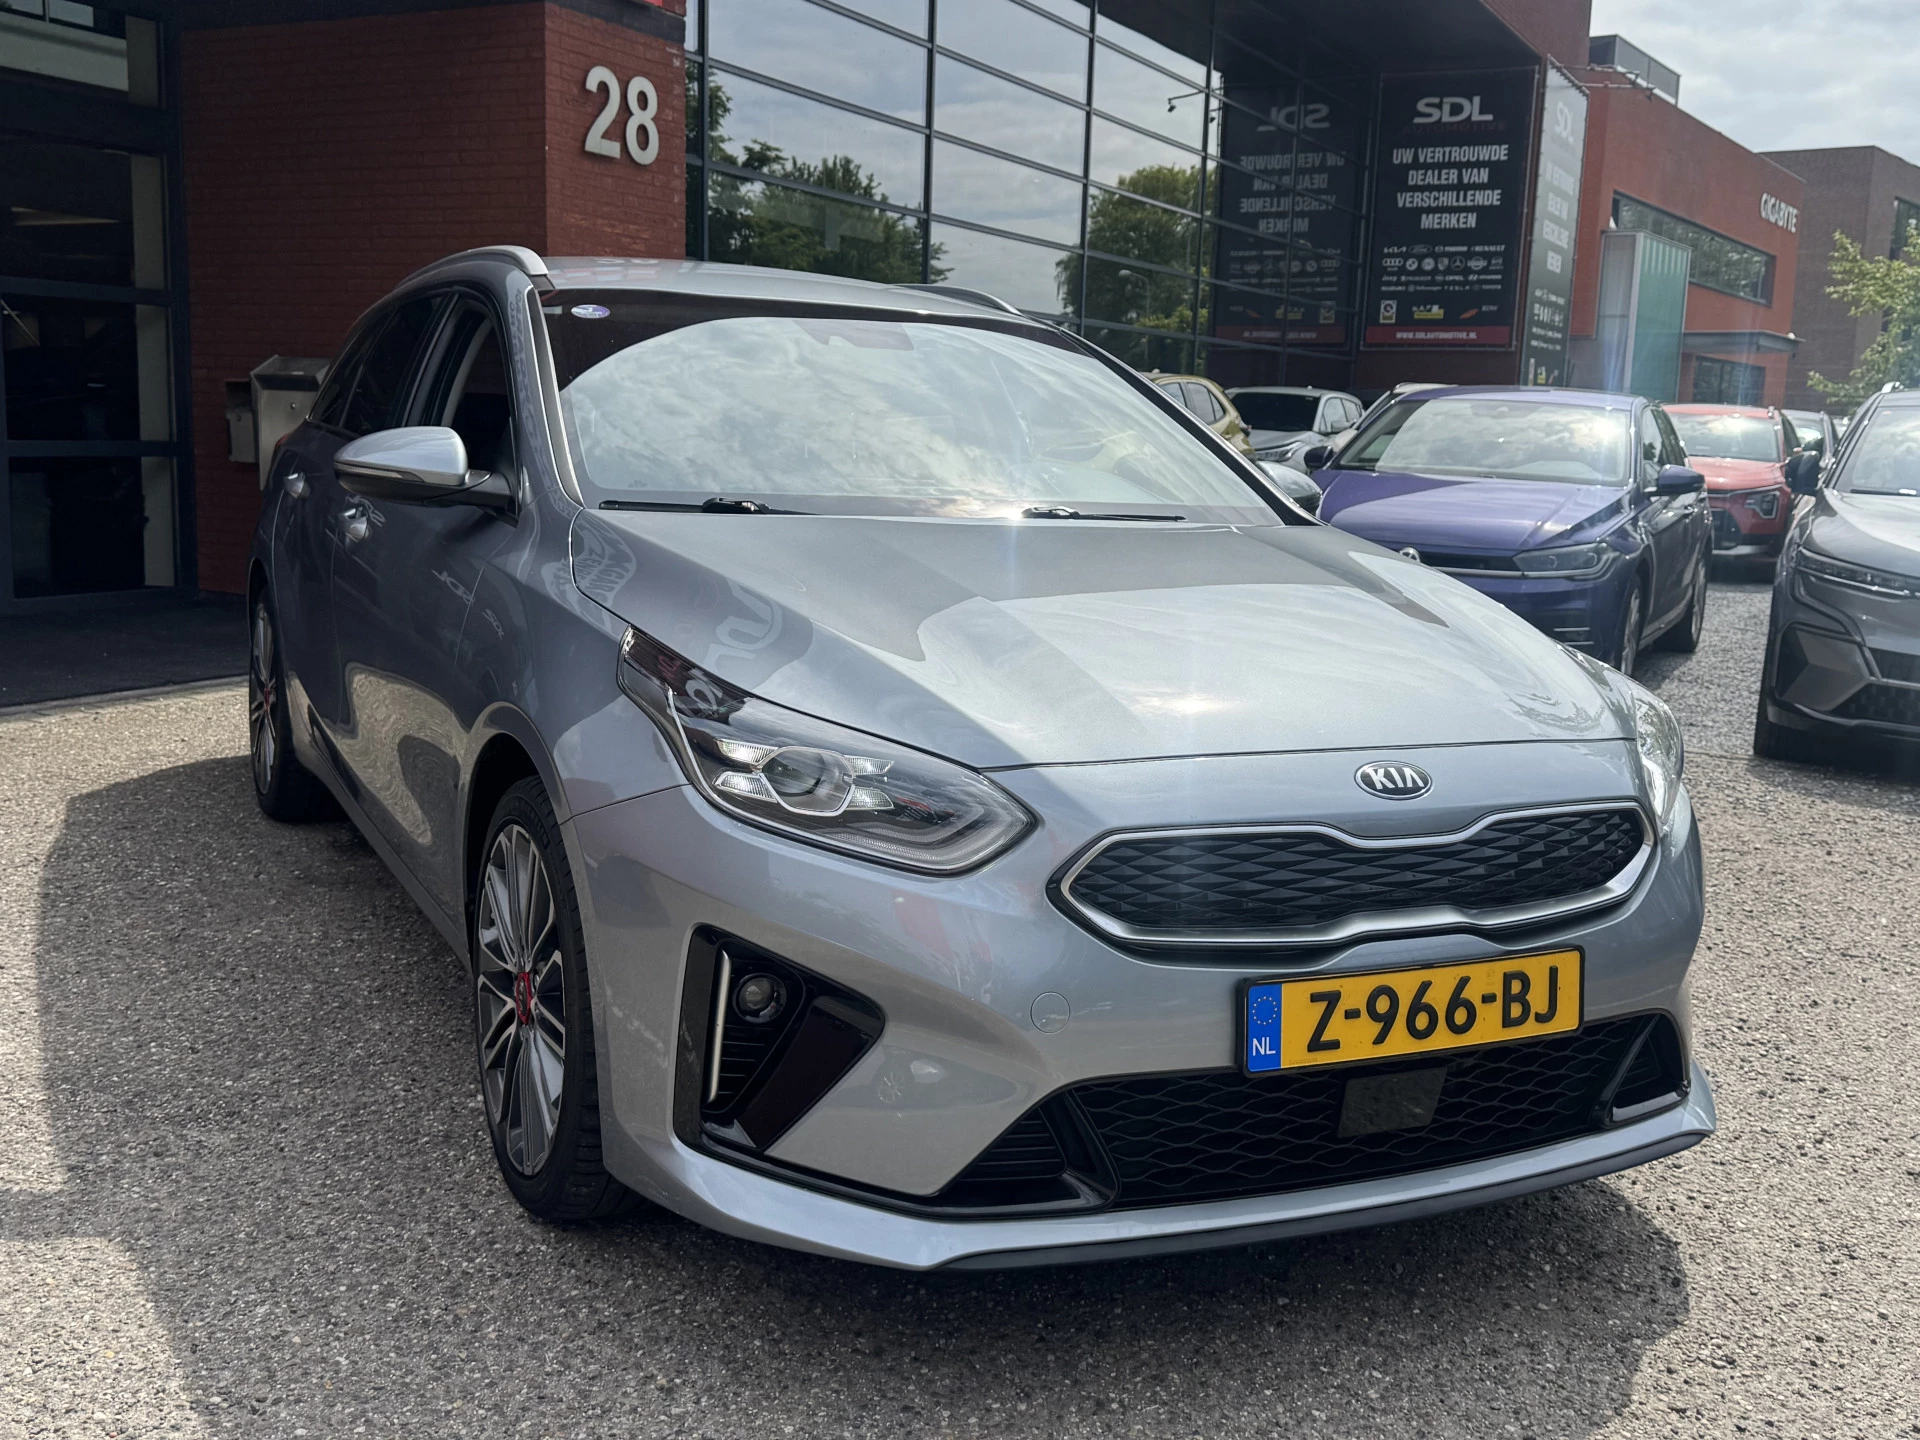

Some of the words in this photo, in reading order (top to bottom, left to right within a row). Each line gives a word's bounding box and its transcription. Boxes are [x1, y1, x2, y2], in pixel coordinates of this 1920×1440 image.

[584, 65, 660, 165] 28
[1412, 95, 1494, 124] SDL
[1392, 148, 1415, 164] UW
[1418, 144, 1509, 163] VERTROUWDE
[1408, 168, 1459, 186] DEALER
[1462, 167, 1490, 184] VAN
[1396, 189, 1502, 208] VERSCHILLENDE
[1420, 213, 1477, 230] MERKEN
[1760, 192, 1799, 234] GIGABYTE
[1365, 767, 1425, 790] KIA
[1252, 1036, 1277, 1057] NL
[1307, 965, 1559, 1053] Z-966-BJ
